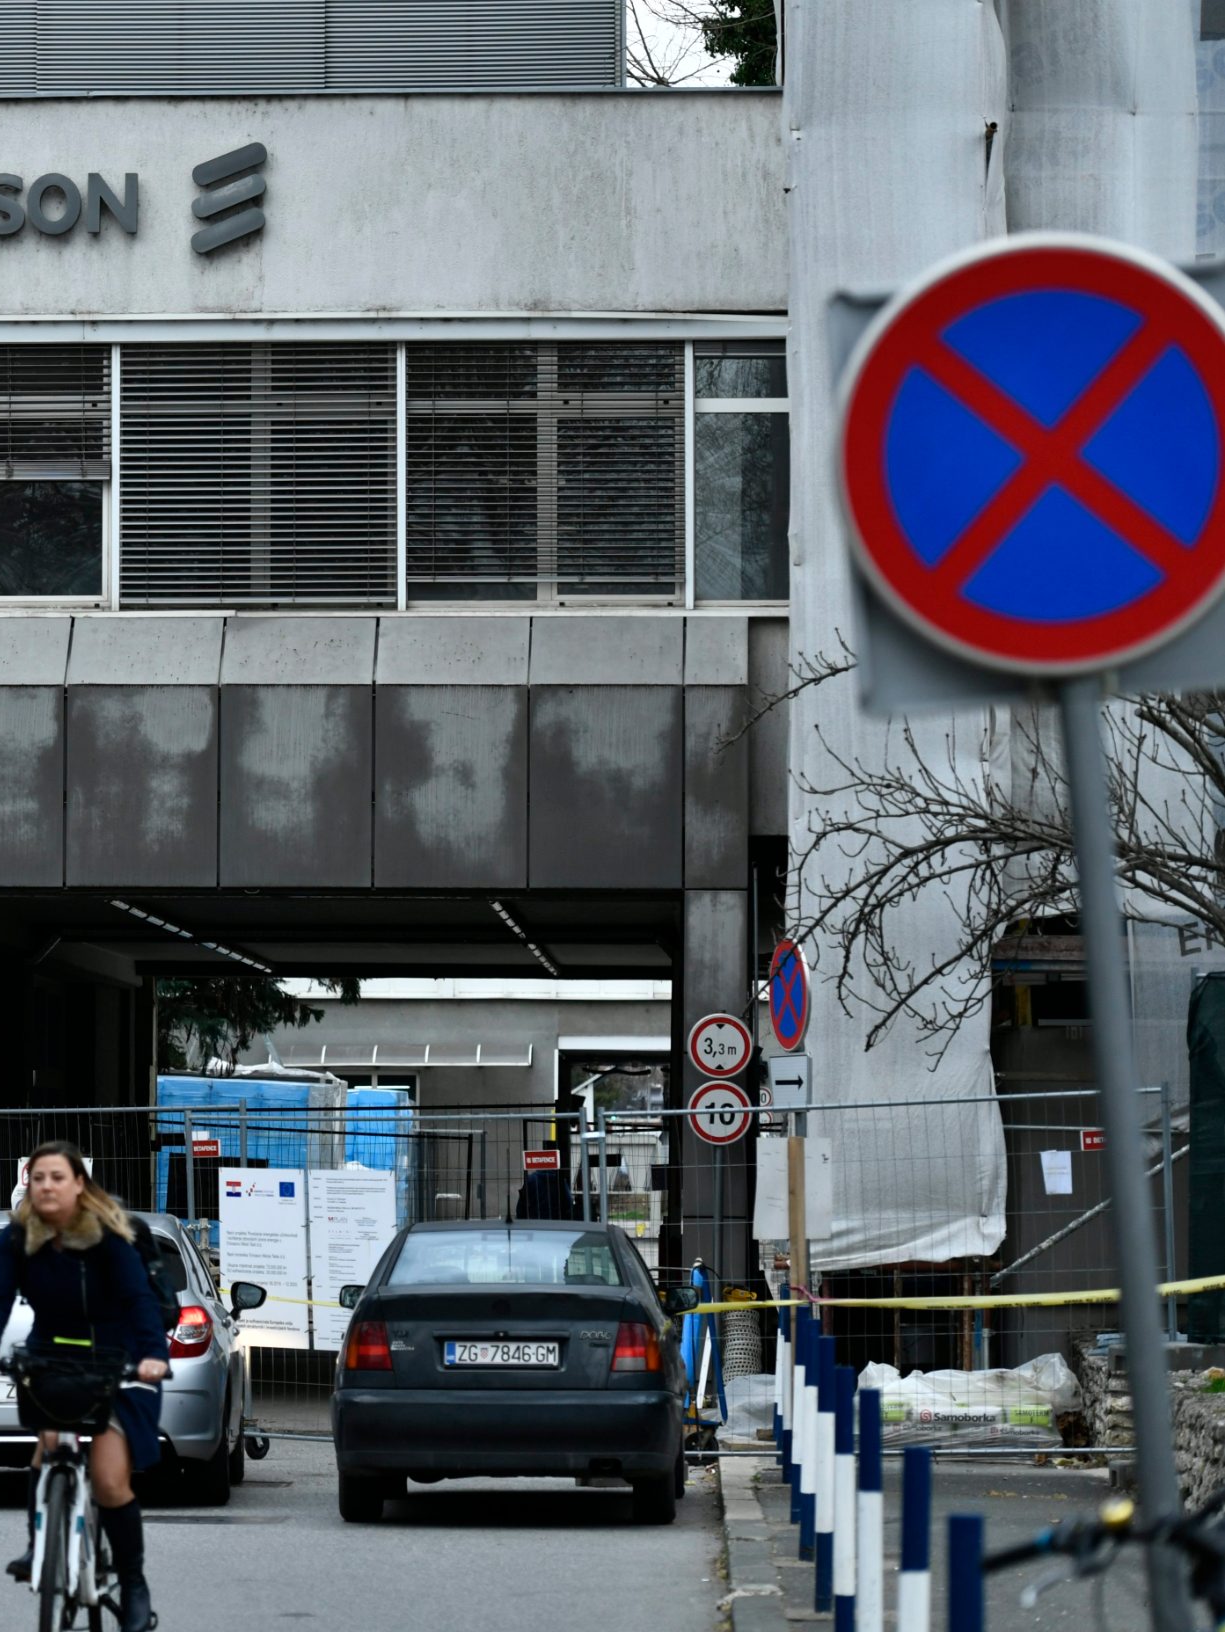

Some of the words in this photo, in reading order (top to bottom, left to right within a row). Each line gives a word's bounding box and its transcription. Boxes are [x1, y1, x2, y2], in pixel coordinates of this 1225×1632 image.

[704, 1037, 725, 1058] 3,3
[728, 1046, 737, 1055] m
[705, 1102, 736, 1126] 10
[457, 1344, 478, 1362] ZG
[490, 1344, 557, 1362] 7846-GM
[934, 1412, 996, 1422] Samoborka
